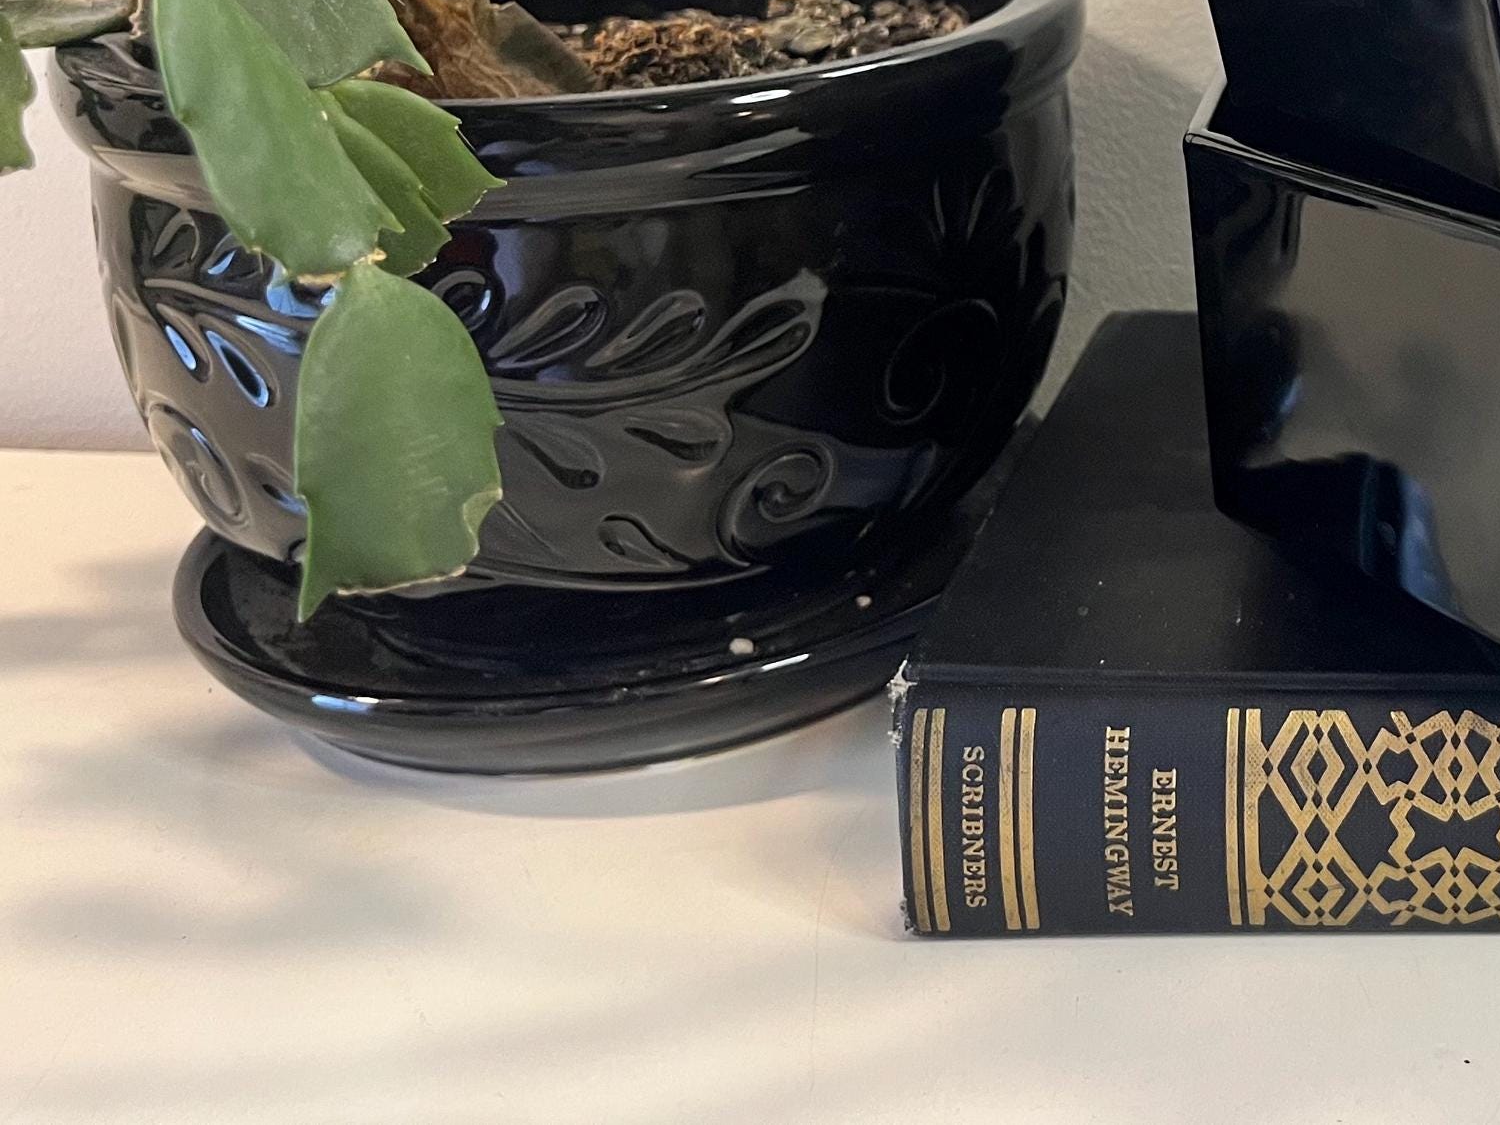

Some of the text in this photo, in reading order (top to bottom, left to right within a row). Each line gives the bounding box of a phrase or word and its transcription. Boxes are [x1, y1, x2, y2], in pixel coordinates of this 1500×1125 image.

[961, 746, 988, 909] SCRIBNERS
[1104, 726, 1134, 917] HEMINGWAY
[1152, 768, 1179, 891] ERNEST
